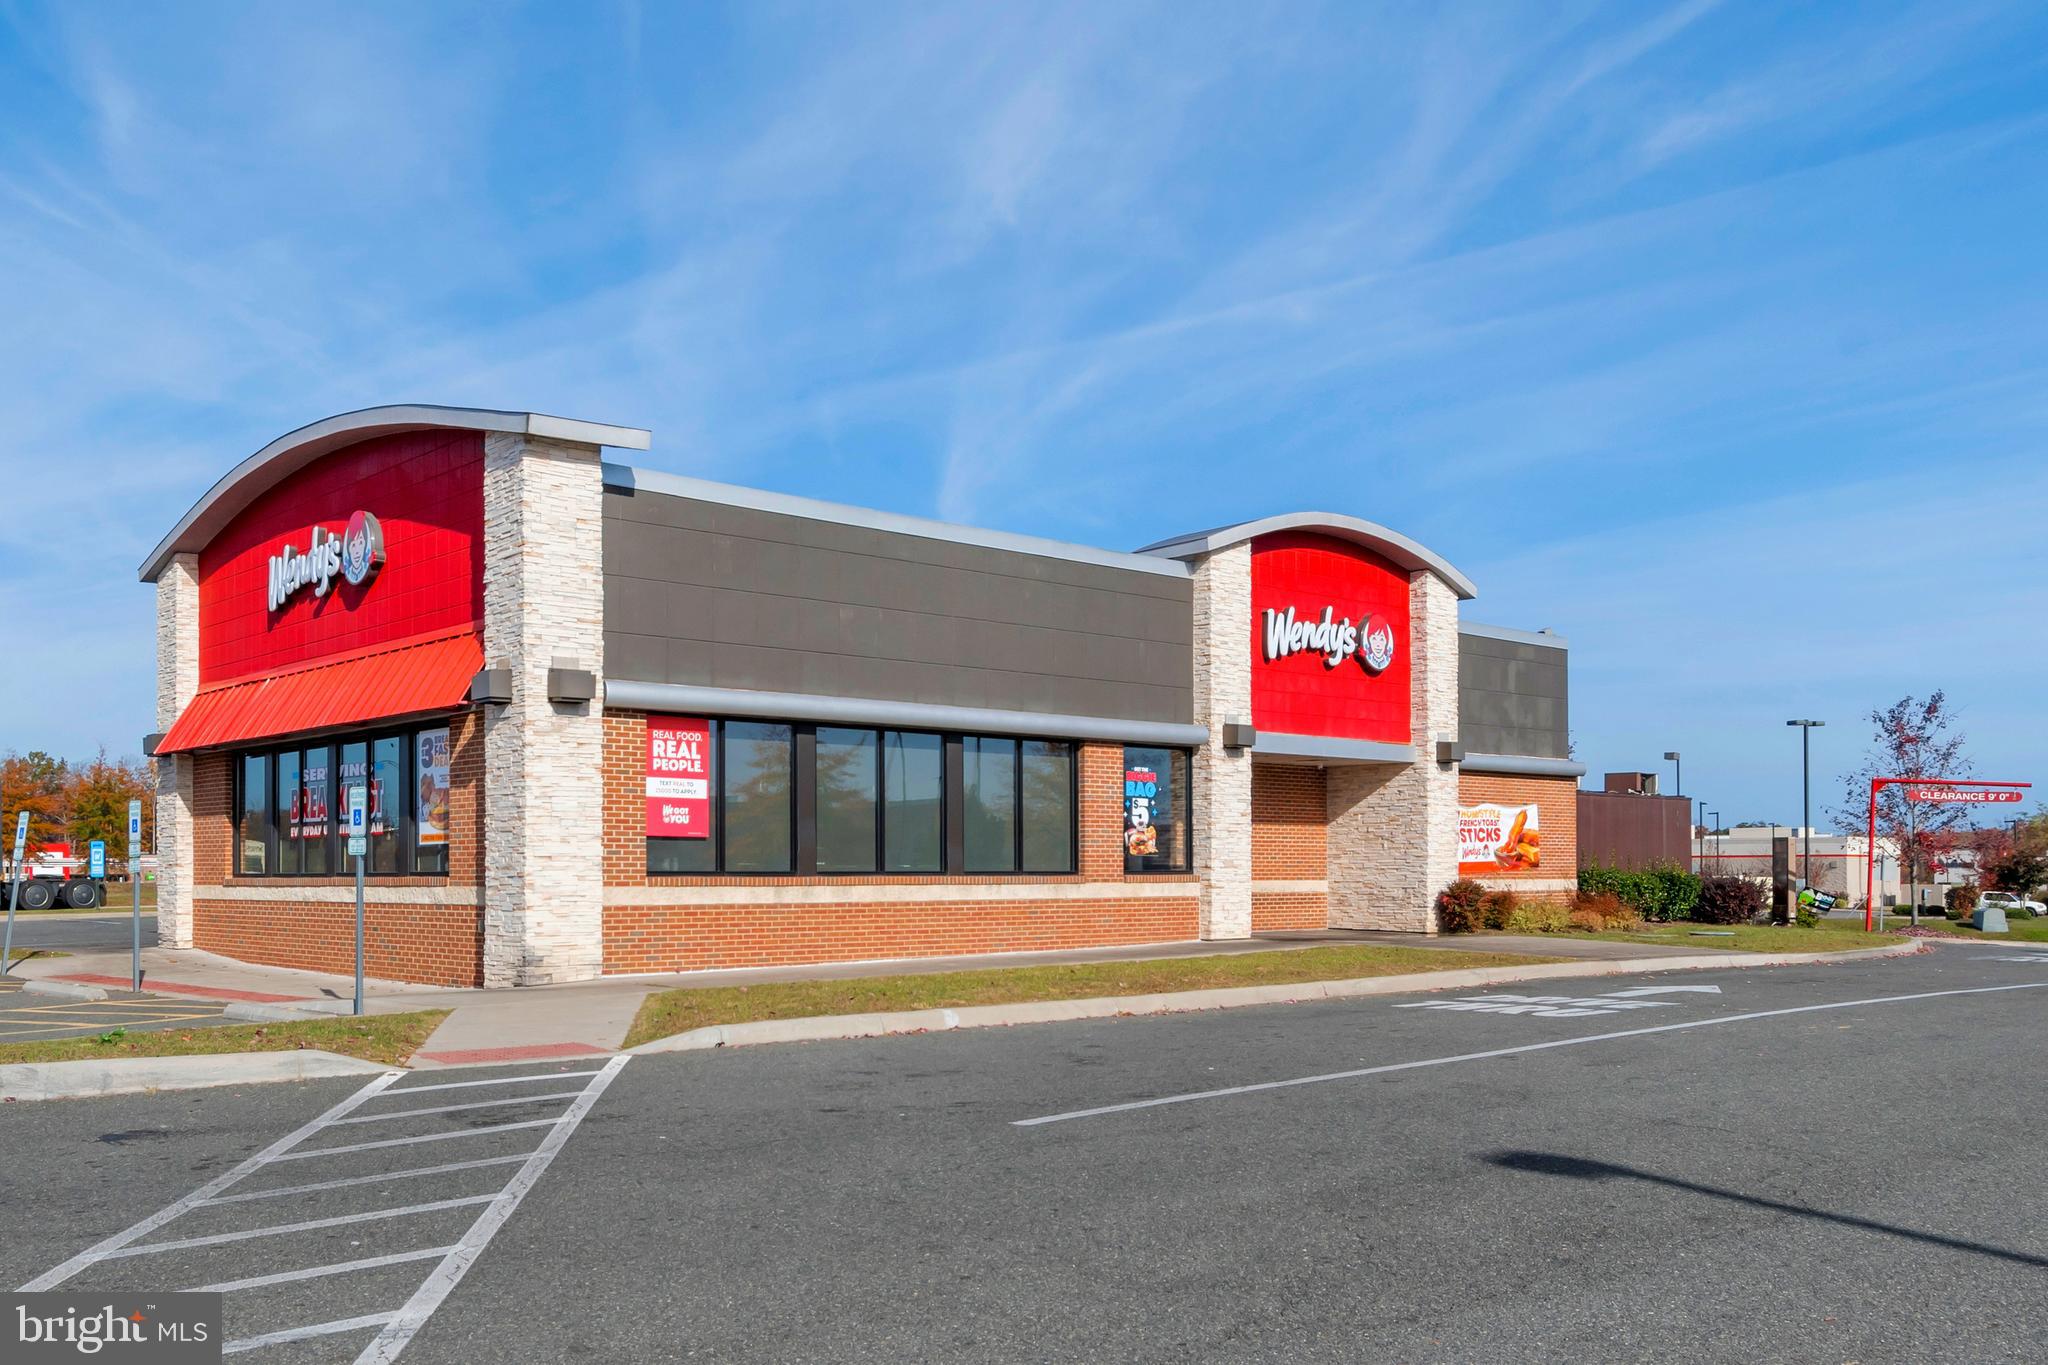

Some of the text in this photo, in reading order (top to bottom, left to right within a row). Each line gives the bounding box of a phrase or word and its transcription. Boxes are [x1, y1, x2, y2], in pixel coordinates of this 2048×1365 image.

[268, 525, 340, 612] Wendy's
[1265, 605, 1357, 666] Wendy's
[652, 730, 675, 740] REAL
[652, 739, 701, 759] REAL
[652, 758, 704, 772] PEOPLE.
[1126, 781, 1157, 798] BAG
[1920, 791, 1985, 801] CLEARANCE
[670, 815, 690, 824] YOU
[1460, 827, 1501, 843] STICKS
[1391, 1000, 1621, 1017] THRU
